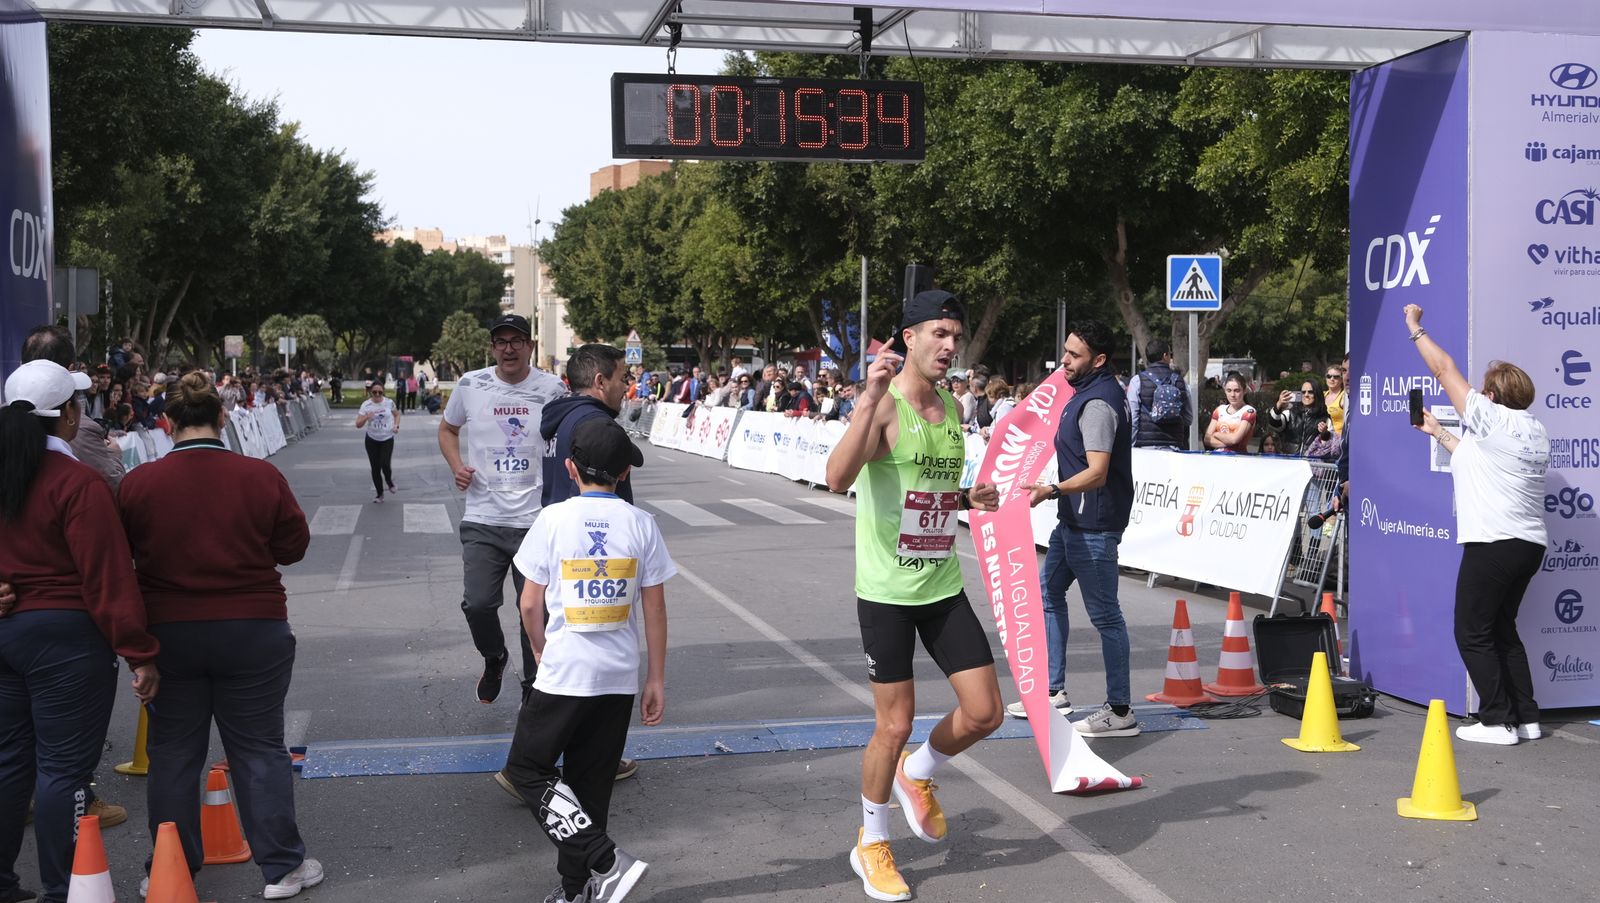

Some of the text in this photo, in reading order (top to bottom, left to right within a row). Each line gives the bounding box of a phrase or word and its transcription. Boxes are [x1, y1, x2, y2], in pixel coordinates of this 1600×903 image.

[1531, 94, 1600, 108] HYUND
[667, 84, 910, 149] 00:15:34
[1535, 198, 1595, 226] CASI
[10, 208, 48, 281] CDX
[1364, 215, 1442, 291] CDX
[493, 407, 529, 416] MUJER
[1545, 393, 1592, 409] Clece
[494, 458, 530, 472] 1129
[914, 452, 962, 469] Universo
[920, 467, 961, 483] Running
[1210, 487, 1292, 522] ALMERÍA
[1544, 486, 1594, 519] ego
[584, 521, 610, 529] MUJER
[918, 511, 950, 529] 617
[1209, 519, 1248, 540] CIUDAD
[980, 522, 997, 552] ES
[1541, 553, 1599, 573] Lanjarón
[573, 578, 628, 599] 1662
[985, 554, 1010, 660] NUESTR
[1007, 546, 1035, 695] LA IGUALDAD
